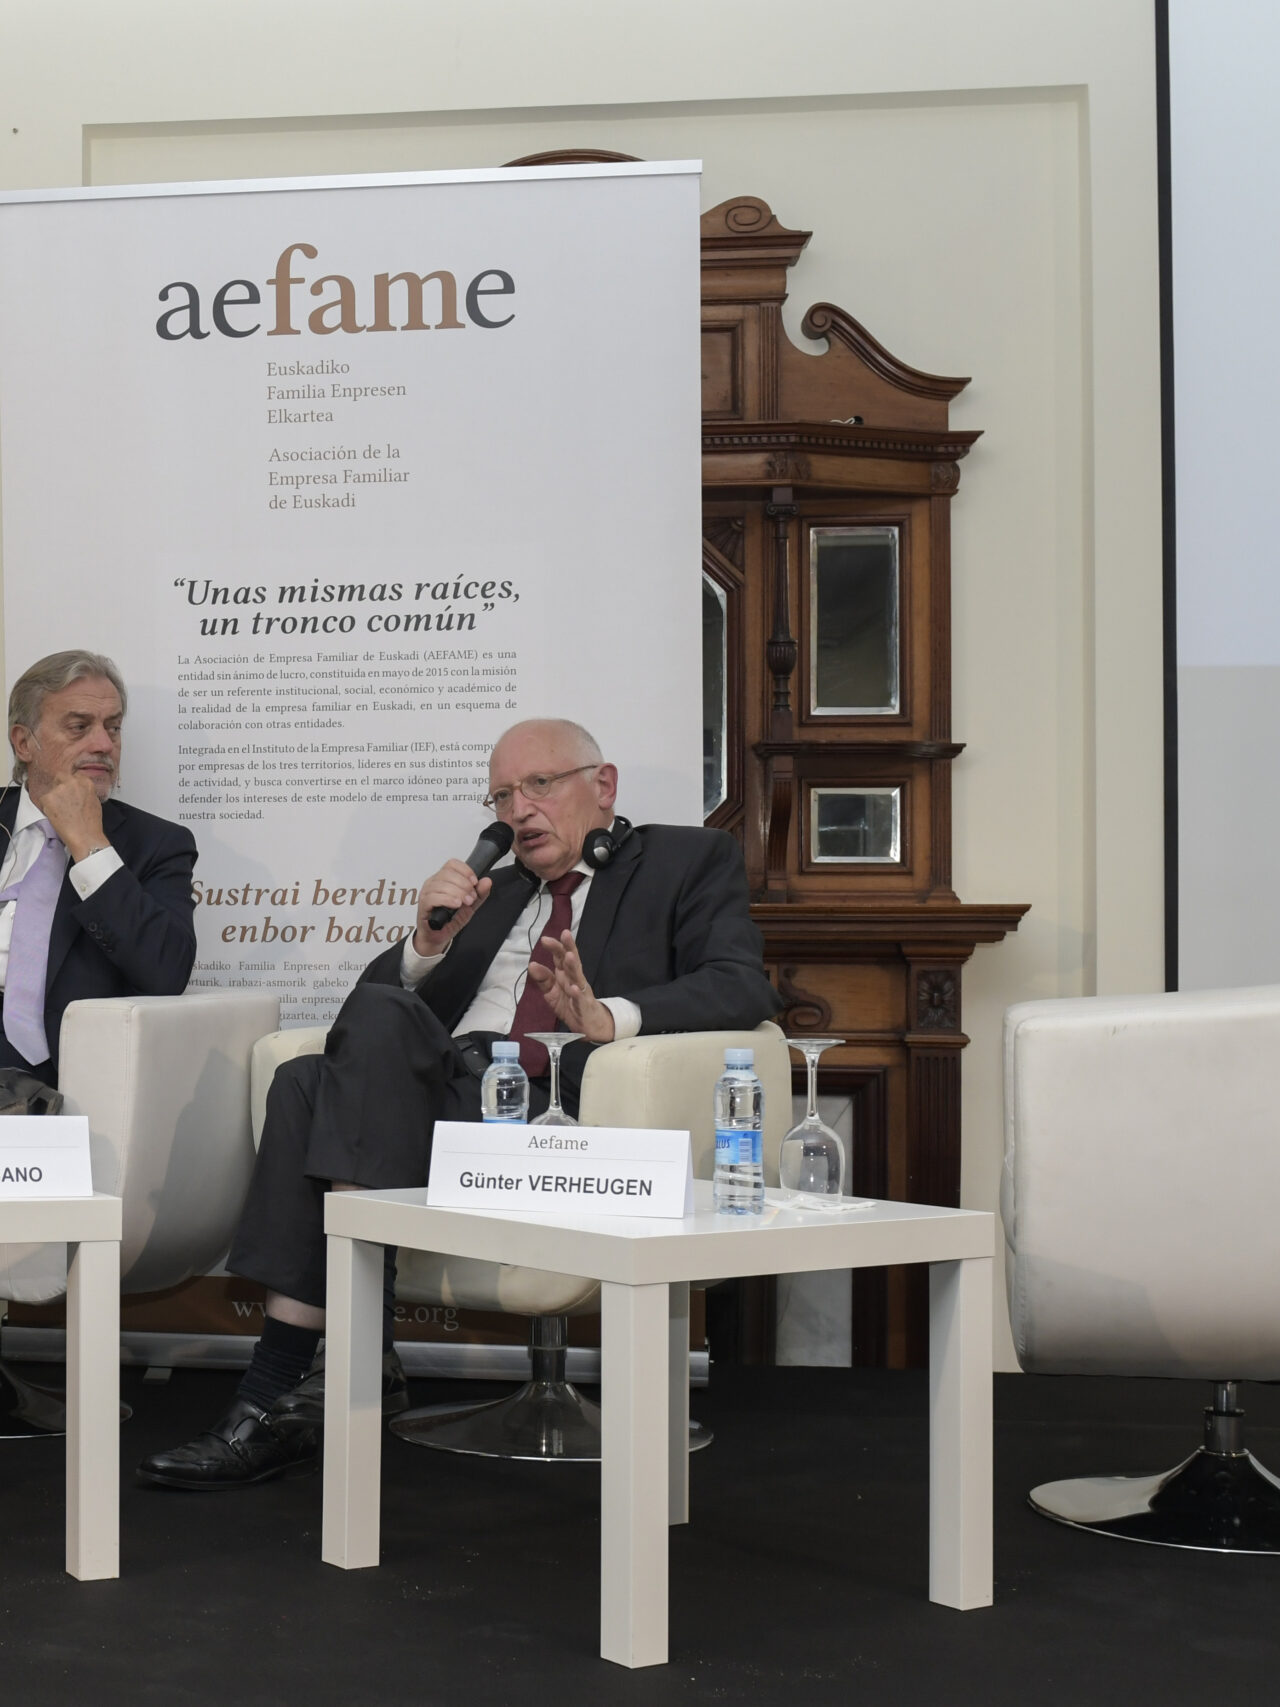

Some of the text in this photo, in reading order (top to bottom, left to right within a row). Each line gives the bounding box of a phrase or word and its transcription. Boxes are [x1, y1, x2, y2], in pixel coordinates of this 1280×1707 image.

[155, 242, 515, 341] aefame
[266, 358, 350, 376] Euskadiko
[266, 383, 407, 402] Familia Enpresen
[267, 408, 334, 424] Elkartea
[268, 443, 400, 462] Asociación de la
[268, 467, 410, 490] Empresa Familiar
[268, 491, 355, 510] de Euskadi
[173, 573, 519, 606] “Unas mismas raíces,
[199, 601, 494, 636] un tronco común”
[177, 649, 517, 665] La Asociación de Empresa Familiar de Euskadi (AEFAME) es una
[177, 665, 517, 681] entidad sin ánimo de lucro, constituida en mayo de 2015 con la misión
[177, 681, 517, 698] de ser un referente institucional, social, económico y académico de
[177, 703, 187, 714] la
[191, 703, 232, 714] realidad
[235, 702, 248, 713] de
[251, 702, 261, 713] la
[264, 704, 308, 715] empresa
[311, 701, 352, 712] familiar
[355, 703, 368, 711] en
[372, 699, 416, 711] Euskadi,
[437, 702, 451, 710] un
[454, 701, 501, 712] esquema
[504, 698, 517, 709] de
[177, 717, 345, 730] colaboración con otras entidades.
[311, 878, 419, 906] berdin
[220, 915, 316, 943] enbor
[238, 960, 275, 970] Familia
[283, 961, 330, 973] Enpresen
[527, 1134, 588, 1151] Aefame
[459, 1171, 652, 1196] Günter VERHEUGEN
